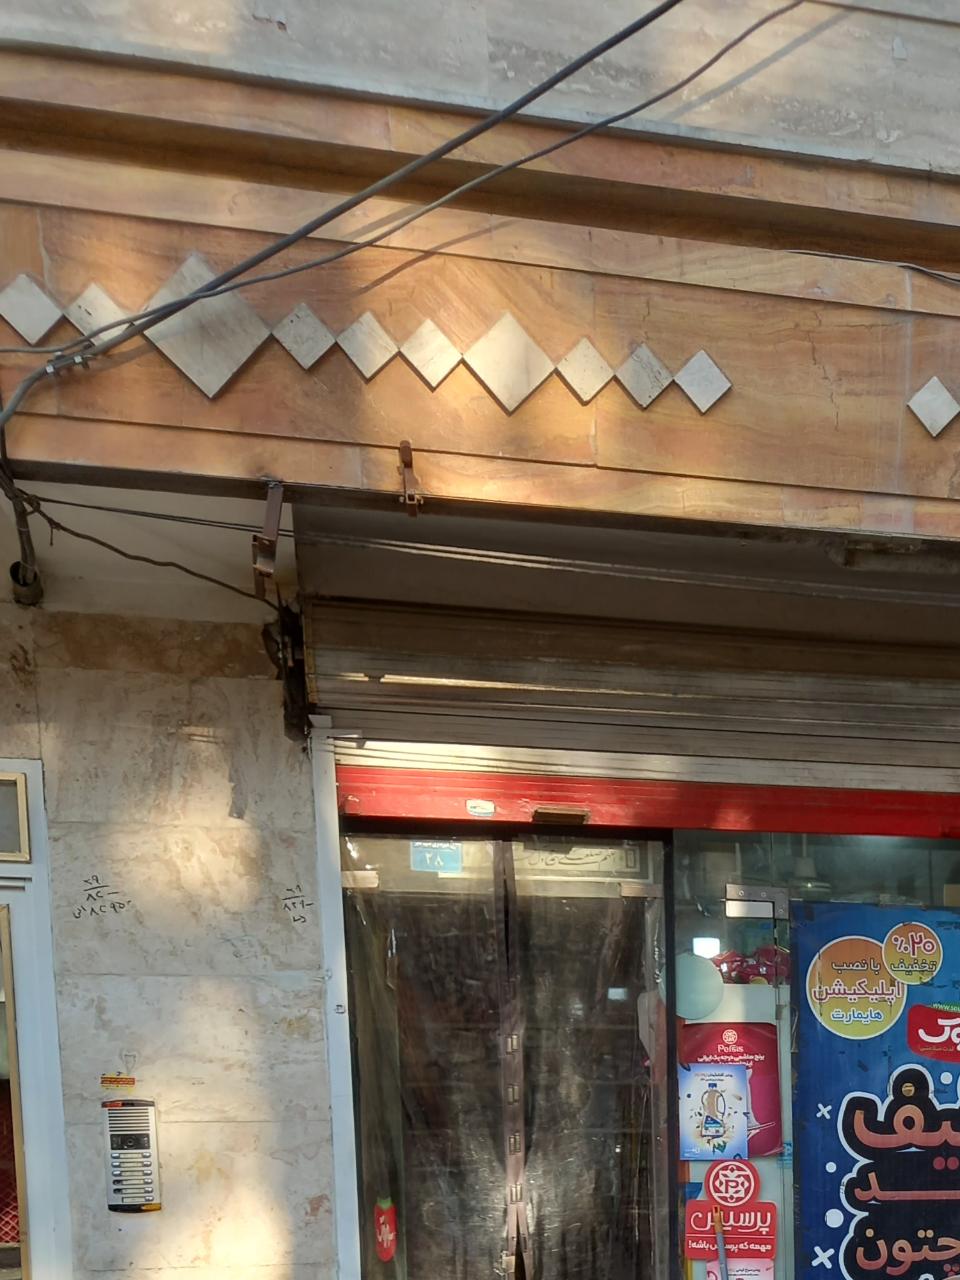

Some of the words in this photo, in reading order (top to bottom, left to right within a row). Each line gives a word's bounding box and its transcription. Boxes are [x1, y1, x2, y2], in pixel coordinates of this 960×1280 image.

[423, 853, 445, 869] ۲۸
[831, 958, 868, 976] نصب
[869, 957, 881, 975] با
[890, 958, 937, 976] تخفیف
[812, 979, 903, 1005] اپلیکیشن
[831, 1007, 884, 1025] هایمارت
[739, 1241, 749, 1250] که
